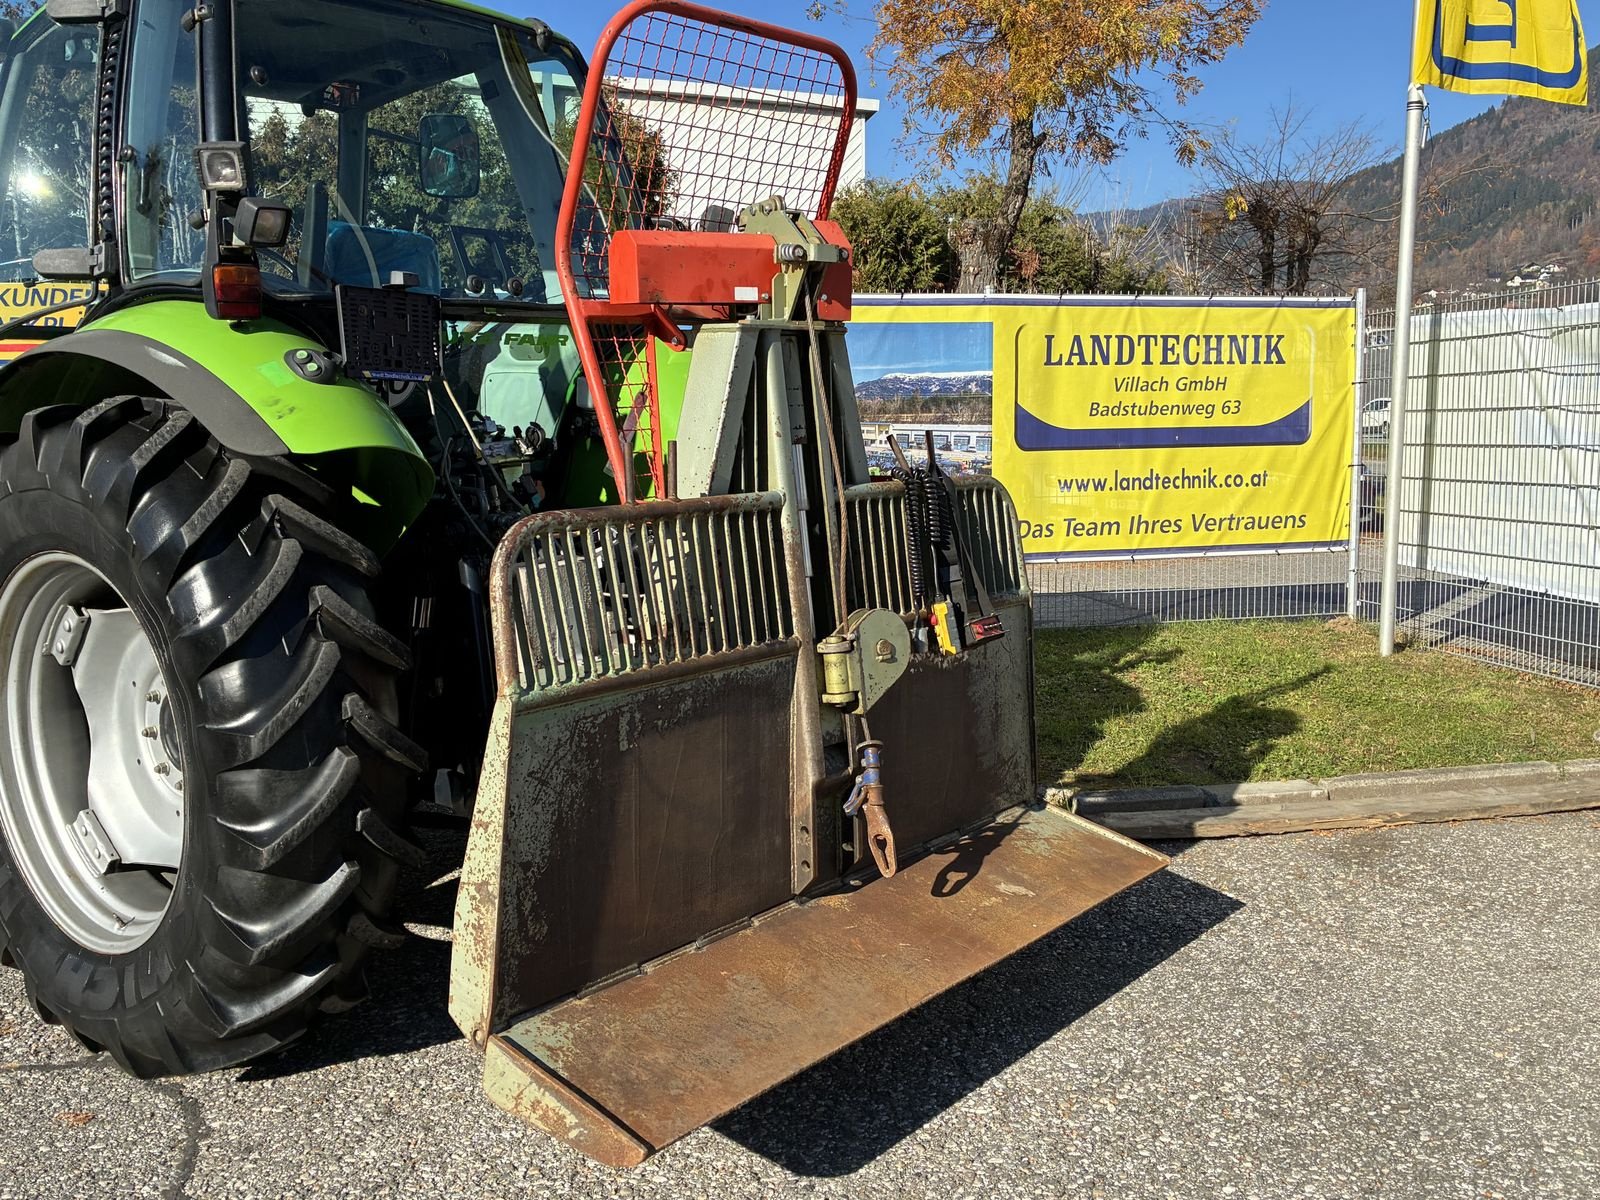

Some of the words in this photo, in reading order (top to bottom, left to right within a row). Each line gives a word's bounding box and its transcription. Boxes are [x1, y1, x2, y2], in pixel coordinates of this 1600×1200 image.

[1044, 334, 1286, 366] LANDTECHNIK
[1114, 376, 1169, 393] Villach
[1175, 376, 1228, 392] GmbH
[1089, 400, 1216, 418] Badstubenweg
[1221, 400, 1242, 415] 63
[1057, 467, 1269, 493] www.landtechnik.co.at
[1017, 519, 1054, 539] Das
[1063, 517, 1121, 537] Team
[1128, 514, 1183, 535] Ihres
[1191, 511, 1307, 532] Vertrauens
